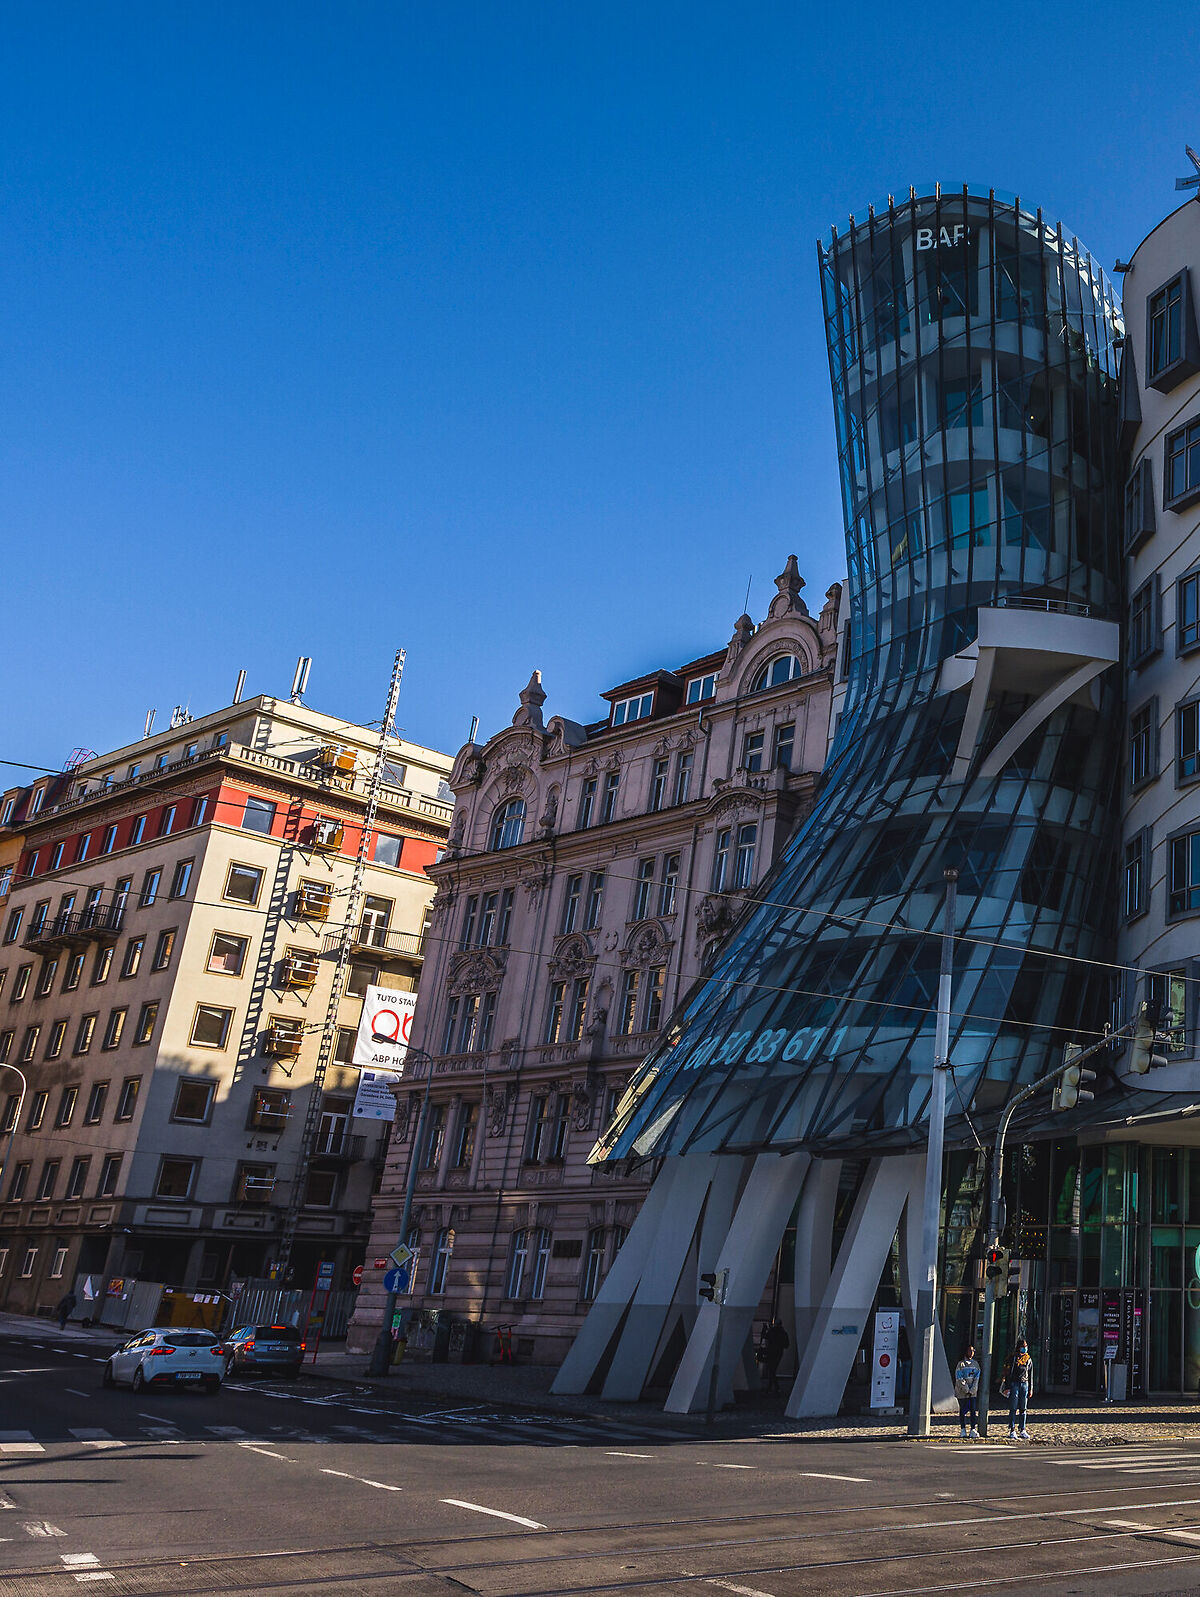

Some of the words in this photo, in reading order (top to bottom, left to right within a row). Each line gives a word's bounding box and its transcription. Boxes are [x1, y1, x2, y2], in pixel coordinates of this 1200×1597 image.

[916, 224, 970, 251] BAR
[376, 993, 397, 1004] TUTO
[371, 1053, 390, 1063] ABP
[1063, 1298, 1072, 1346] GLASS
[1062, 1353, 1071, 1383] BAR
